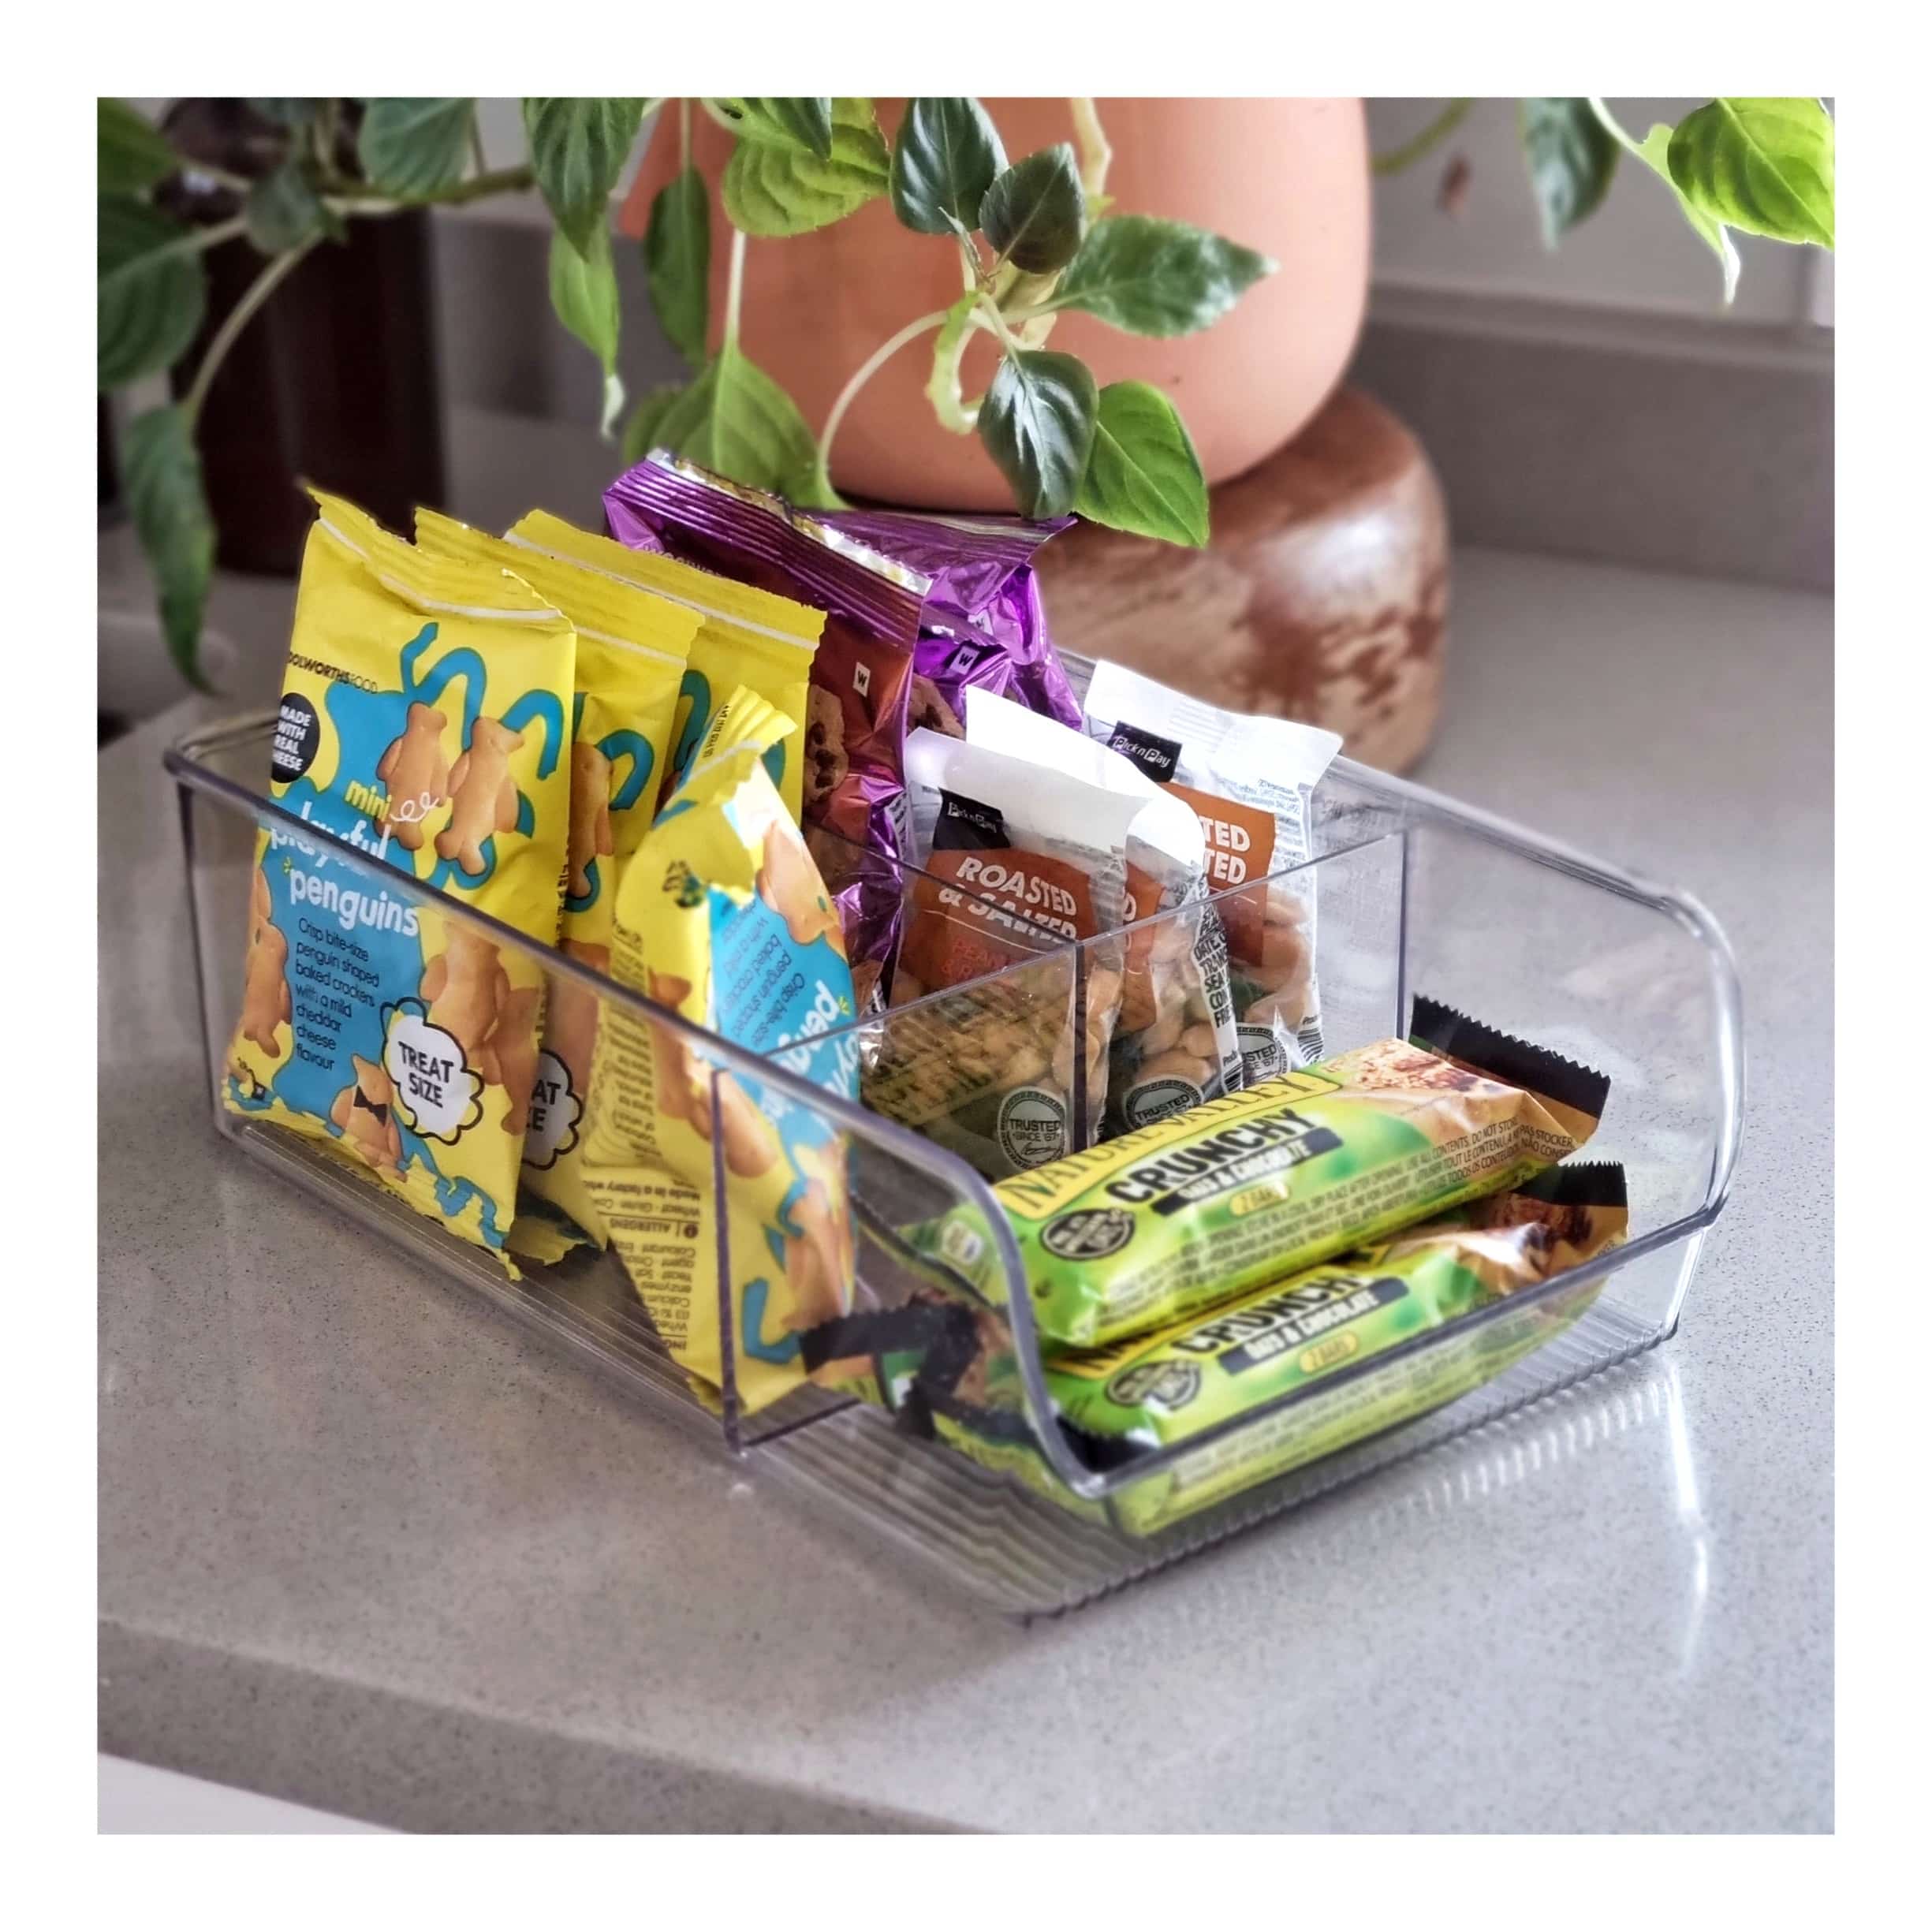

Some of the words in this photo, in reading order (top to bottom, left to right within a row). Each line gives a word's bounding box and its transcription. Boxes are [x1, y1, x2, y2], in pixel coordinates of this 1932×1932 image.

[278, 720, 306, 740] WITH
[281, 705, 311, 726] MADE
[272, 749, 303, 770] HEESE
[275, 735, 299, 755] REAL
[345, 779, 392, 822] mini
[289, 868, 419, 937] penguins
[957, 856, 1077, 916] ROASTED
[299, 917, 323, 942] Crisp
[326, 929, 369, 962] bite-size
[296, 942, 340, 968] penguin
[342, 960, 379, 987] shaped
[296, 959, 330, 986] baked
[333, 978, 375, 1007] crackers
[296, 984, 318, 1003] with
[321, 995, 328, 1007] a
[330, 998, 352, 1018] mild
[296, 1004, 341, 1032] cheddar
[297, 1024, 337, 1050] cheese
[297, 1042, 334, 1071] flavour
[398, 1041, 453, 1083] TREAT
[409, 1072, 443, 1108] SIZE
[1136, 1094, 1190, 1121] TRUSTED
[1010, 1118, 1061, 1132] TRUSTED
[1010, 1125, 1163, 1210] NATURE
[1164, 1077, 1316, 1128] VALLEY
[1105, 1108, 1318, 1203] CRUNCHY
[1170, 1274, 1361, 1353] CRUNCH
